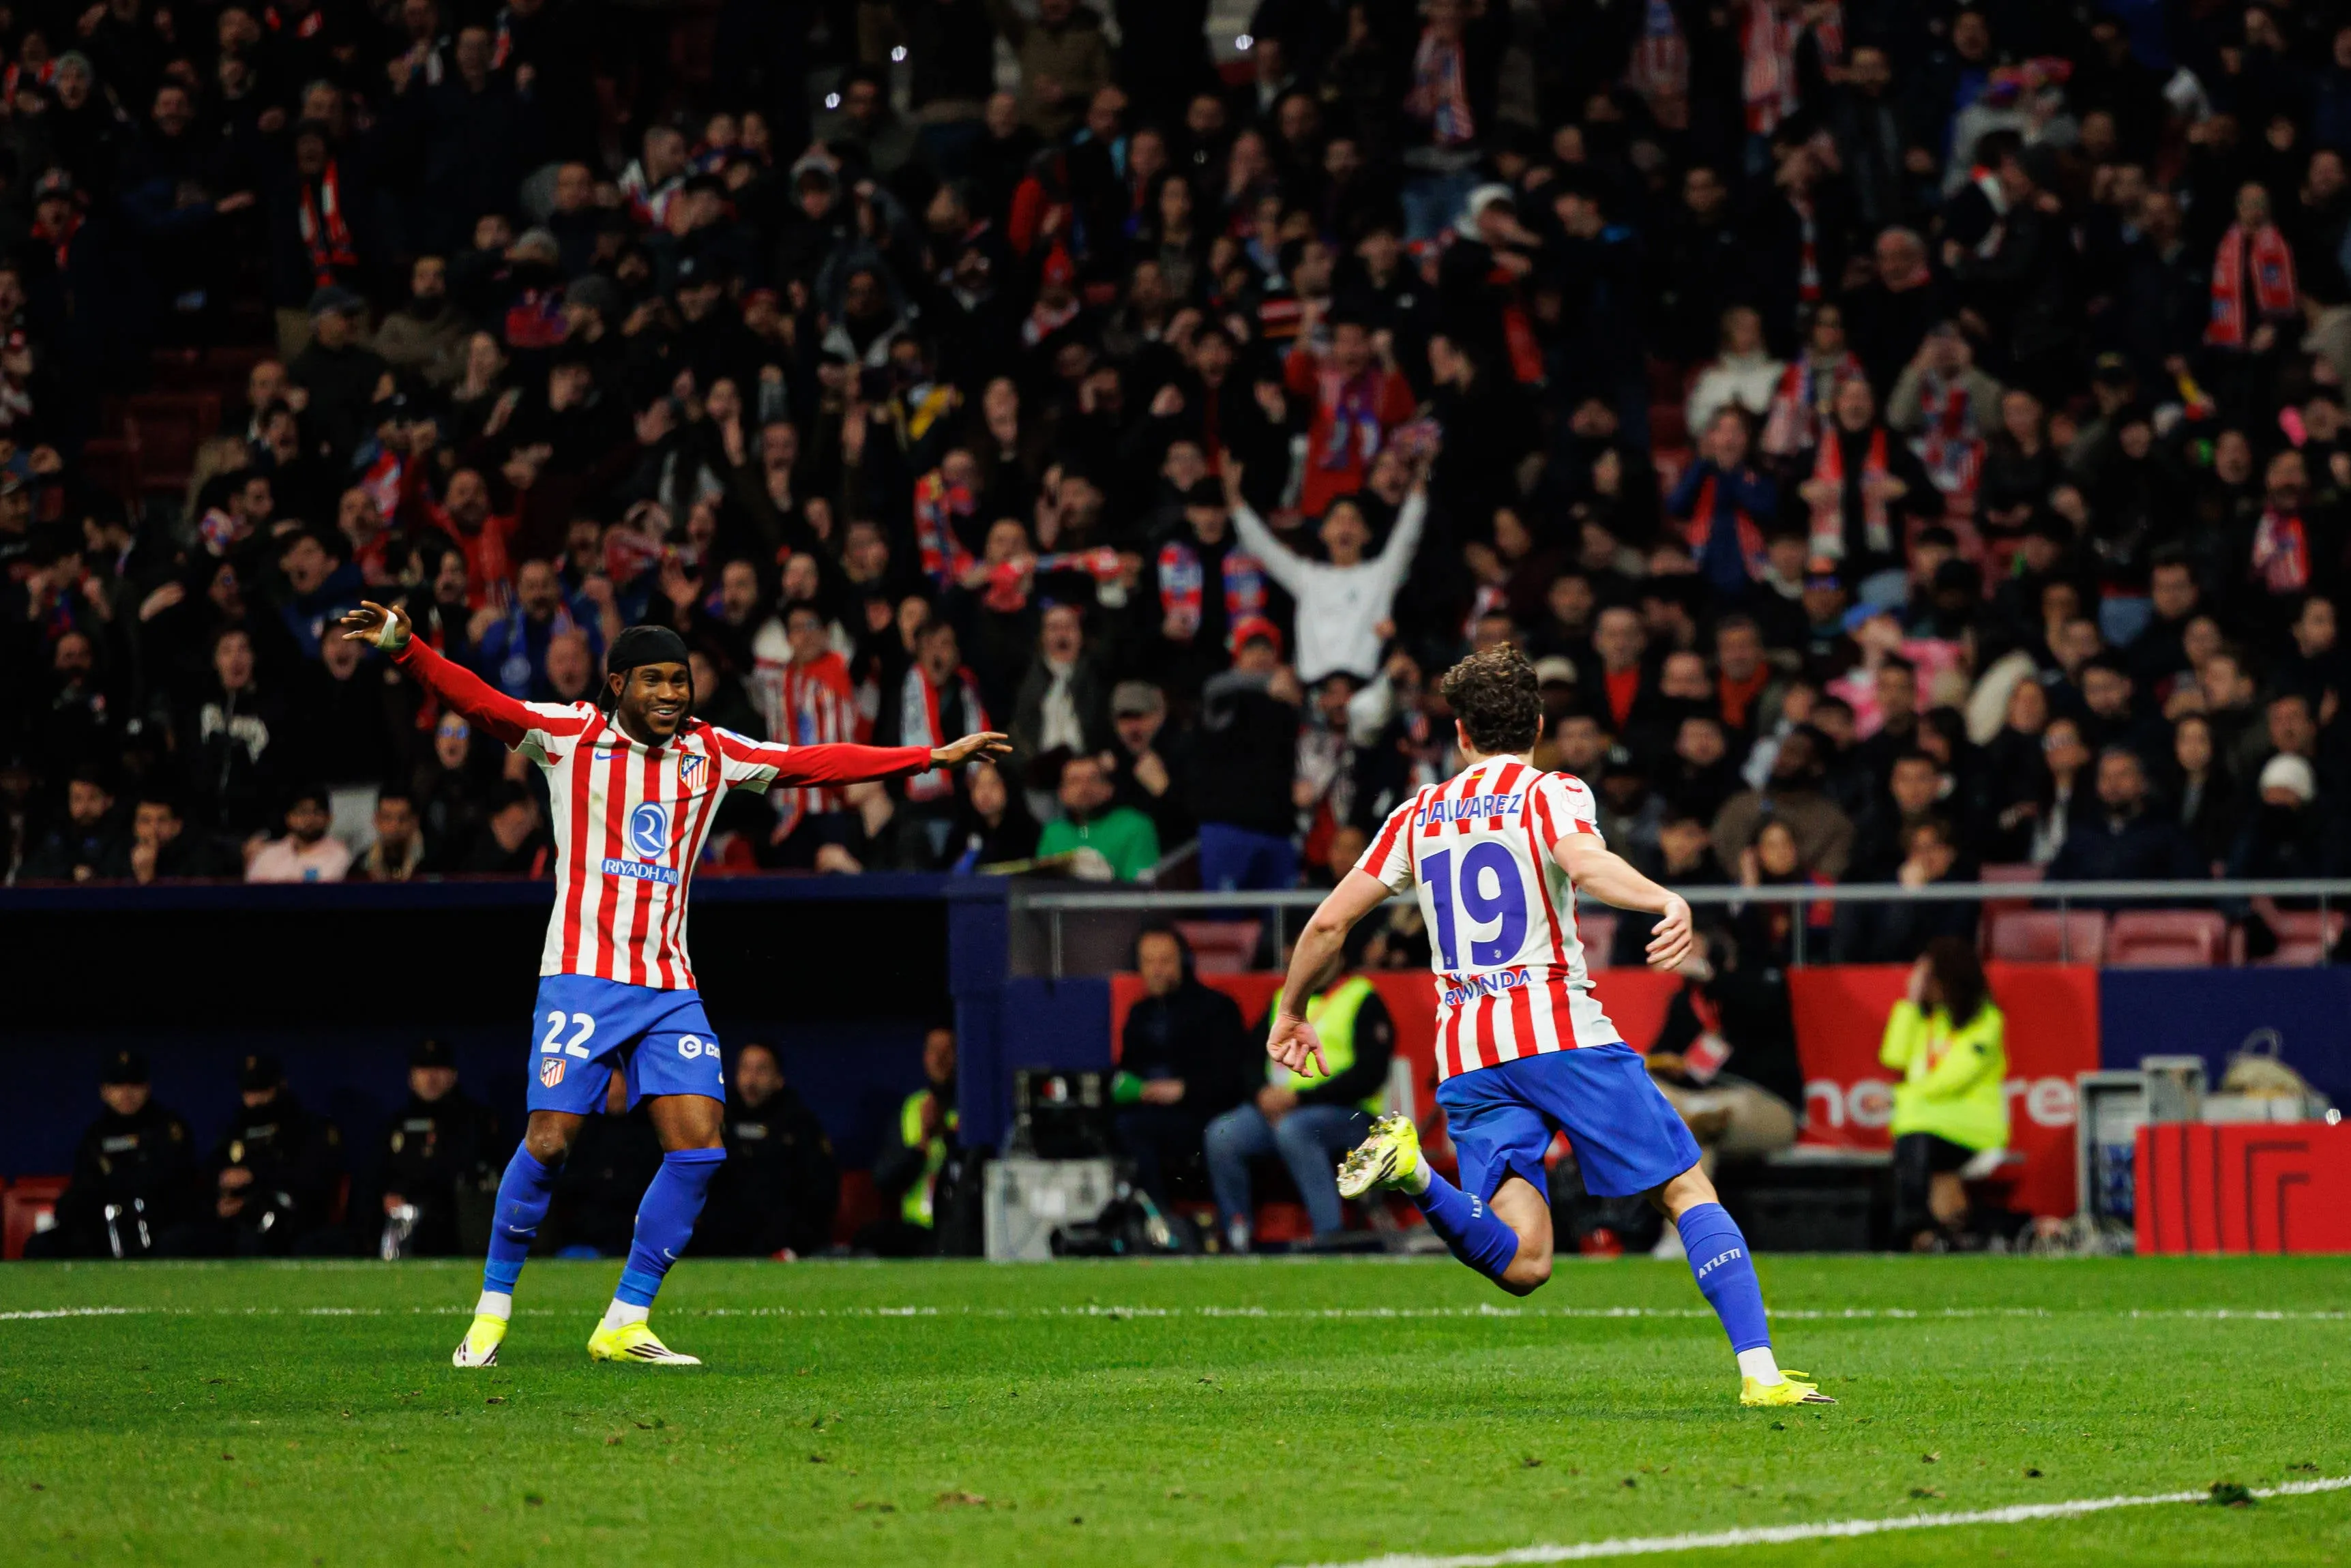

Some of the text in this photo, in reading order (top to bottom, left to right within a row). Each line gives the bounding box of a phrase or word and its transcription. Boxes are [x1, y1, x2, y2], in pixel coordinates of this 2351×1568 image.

[605, 859, 677, 885] RIYADH AIR
[1421, 842, 1527, 970] 19
[1445, 970, 1532, 1005] RWANDA
[541, 1010, 595, 1059] 22
[1698, 1247, 1741, 1279] ATLETI
